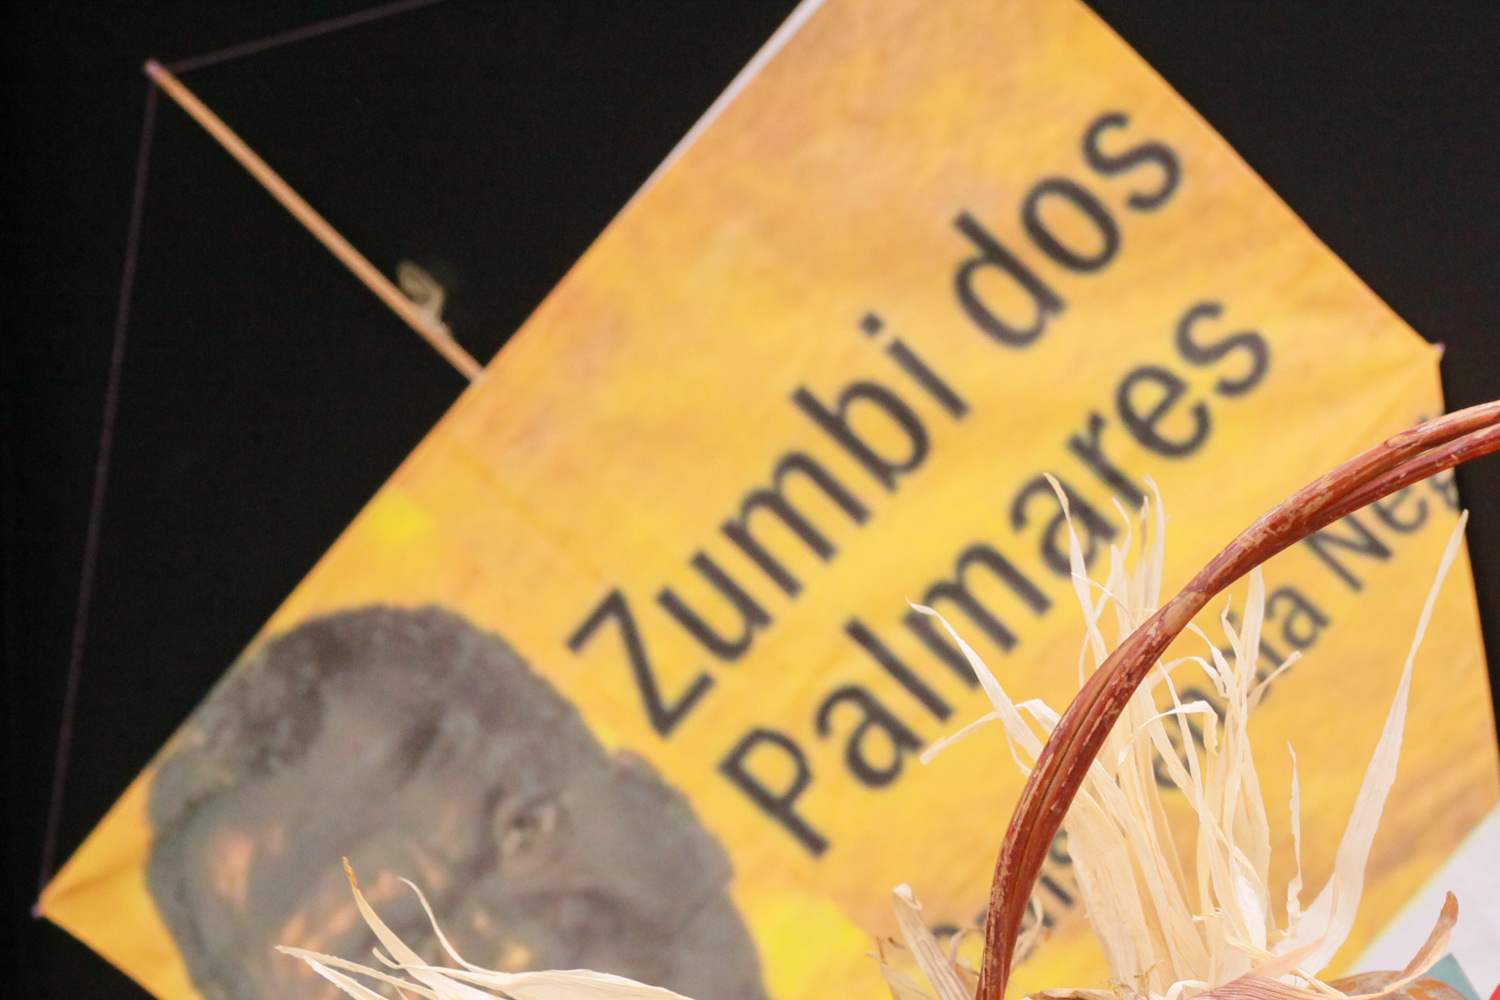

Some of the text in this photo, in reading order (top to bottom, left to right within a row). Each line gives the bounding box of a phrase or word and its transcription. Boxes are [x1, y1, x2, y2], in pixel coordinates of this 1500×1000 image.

[566, 109, 1182, 738] Zumbi dos
[715, 299, 1270, 857] Palmares
